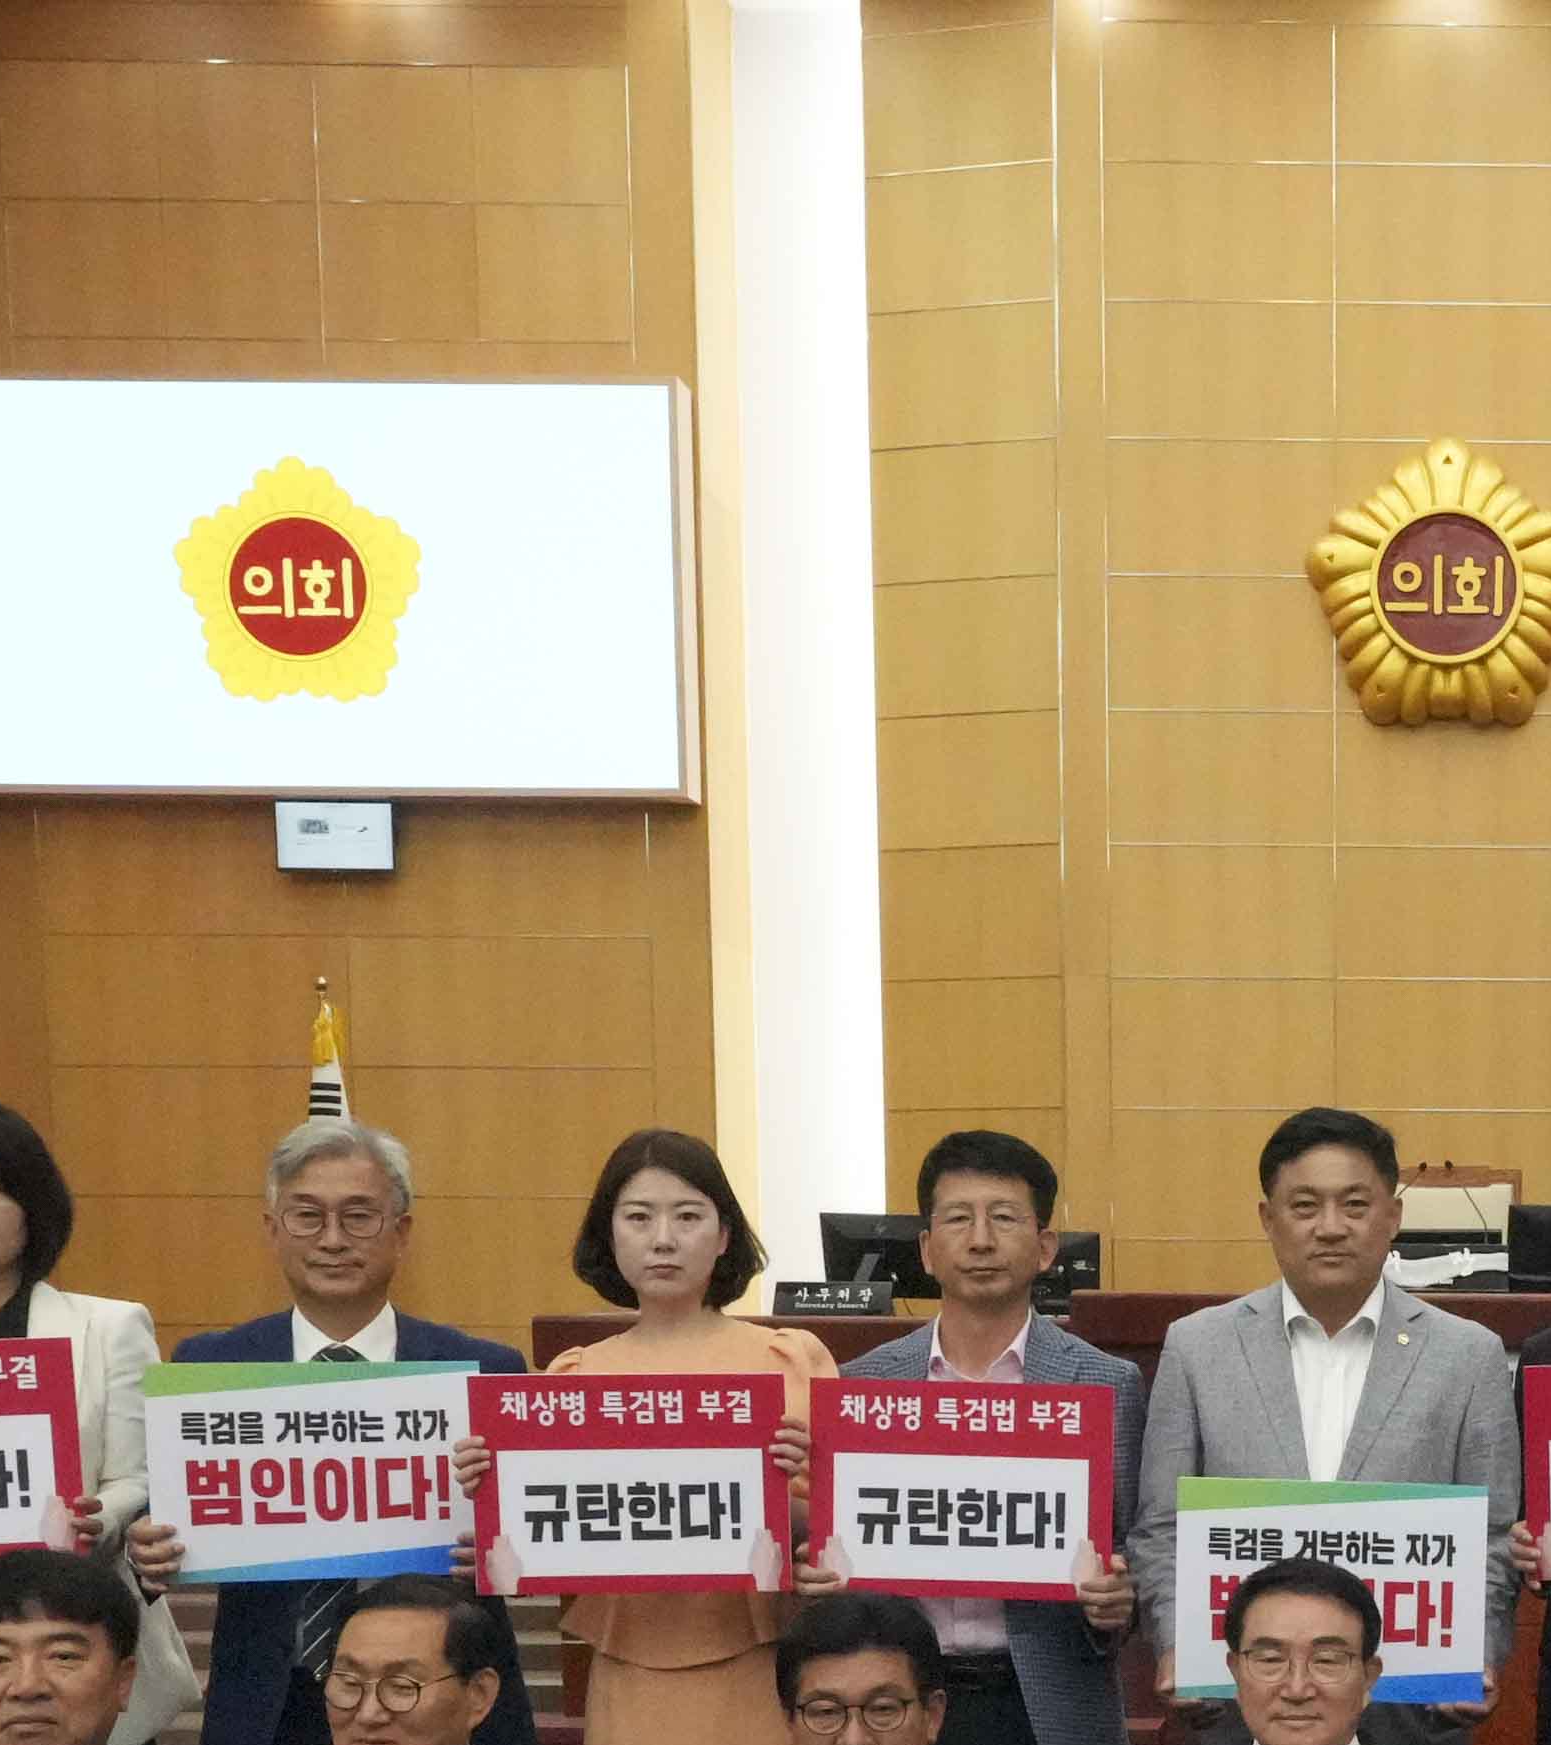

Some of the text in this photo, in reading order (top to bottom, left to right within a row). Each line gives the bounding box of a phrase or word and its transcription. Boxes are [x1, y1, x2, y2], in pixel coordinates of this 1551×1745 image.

[237, 557, 355, 620] 의회
[1384, 553, 1505, 617] 의회
[180, 1409, 450, 1446] 특검을 거부하는 자가
[500, 1389, 752, 1427] 채상병 특검법 부결
[840, 1394, 1081, 1435] 채상병 특검법 부결
[186, 1455, 450, 1525] 범인이다!
[524, 1481, 742, 1543] 규탄한다!
[856, 1487, 1066, 1550] 규탄한다!
[1208, 1527, 1284, 1561] 특검을
[1405, 1533, 1457, 1568] 자가
